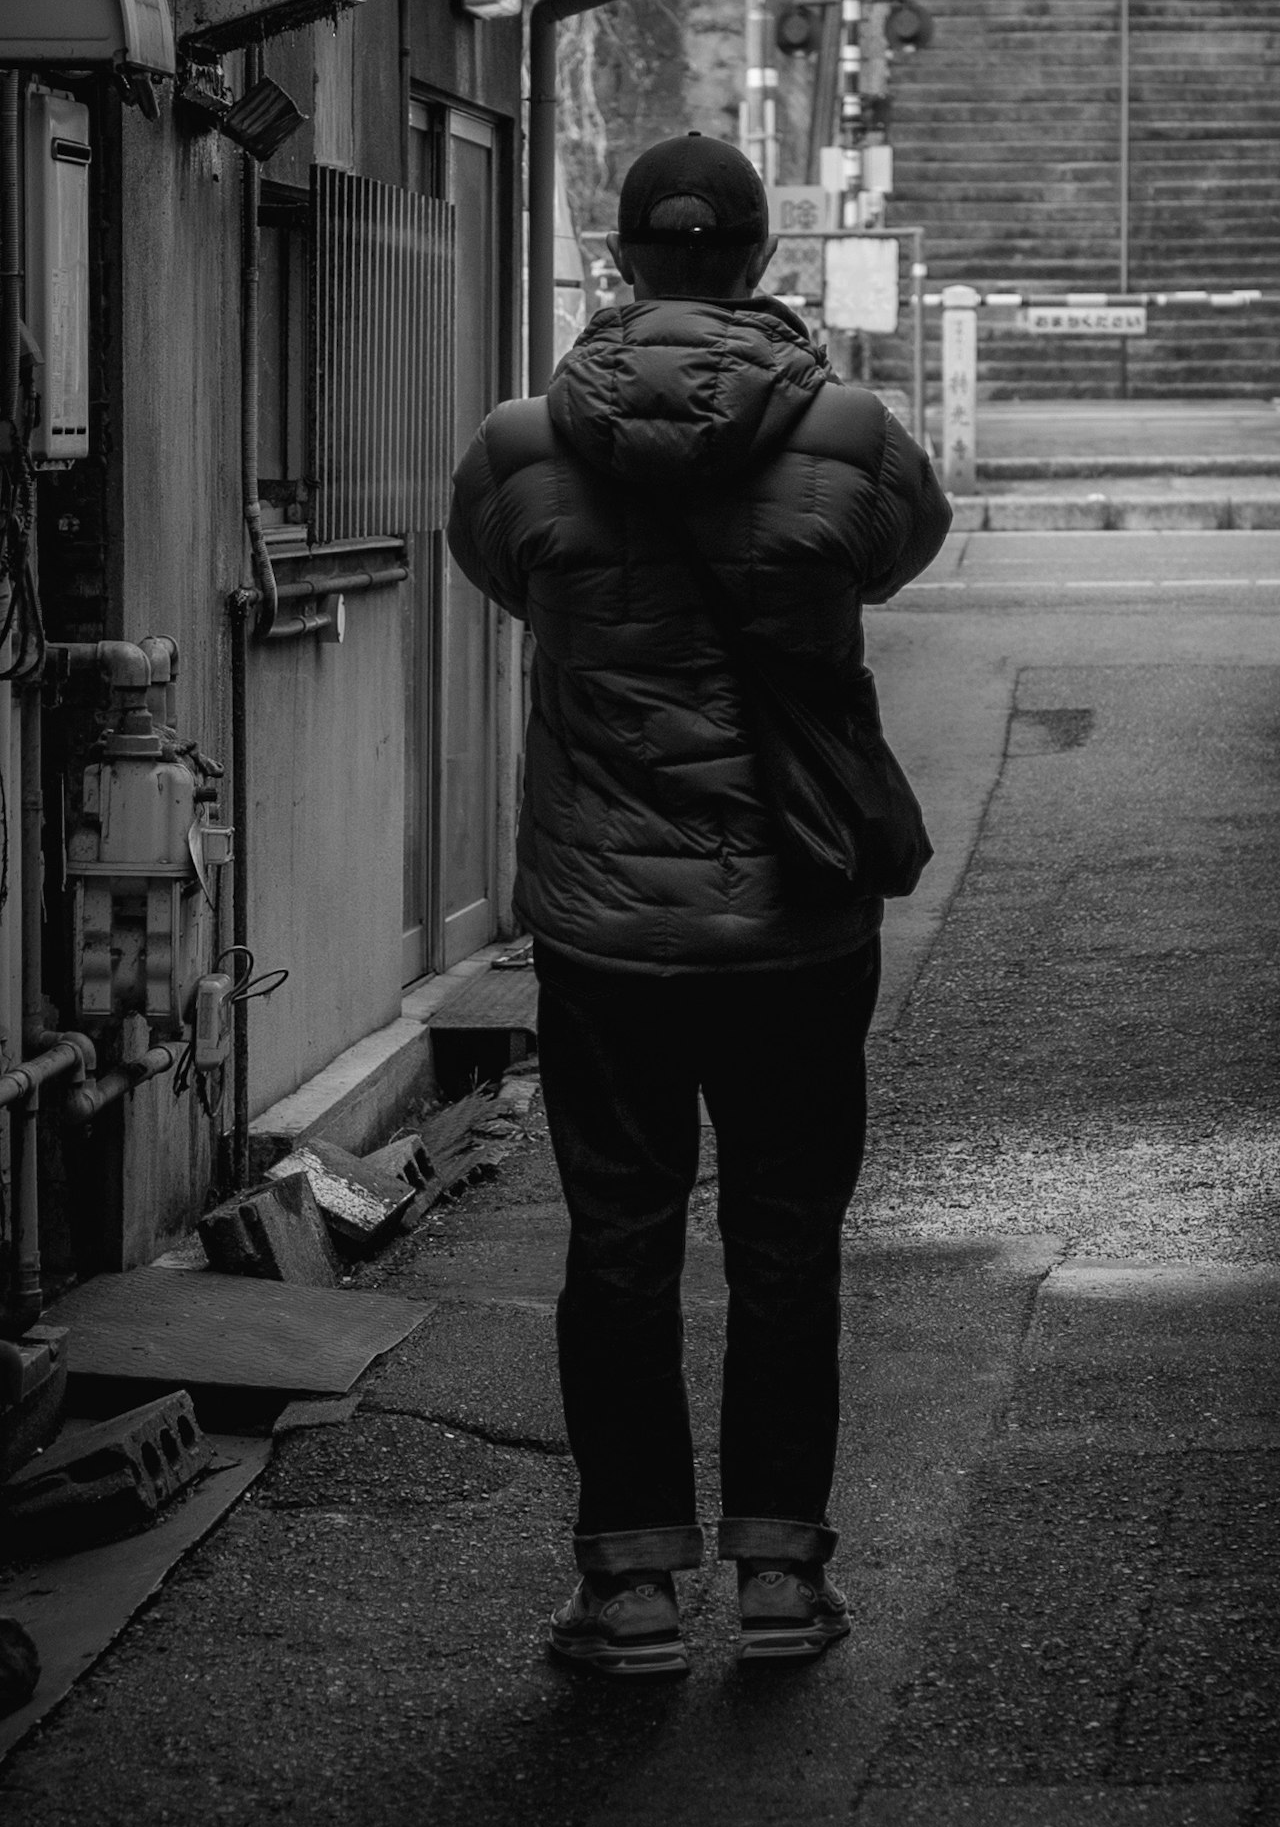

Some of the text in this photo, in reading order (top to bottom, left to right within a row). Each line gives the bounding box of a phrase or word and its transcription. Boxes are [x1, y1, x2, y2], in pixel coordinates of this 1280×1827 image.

[1035, 314, 1143, 330] おまちください
